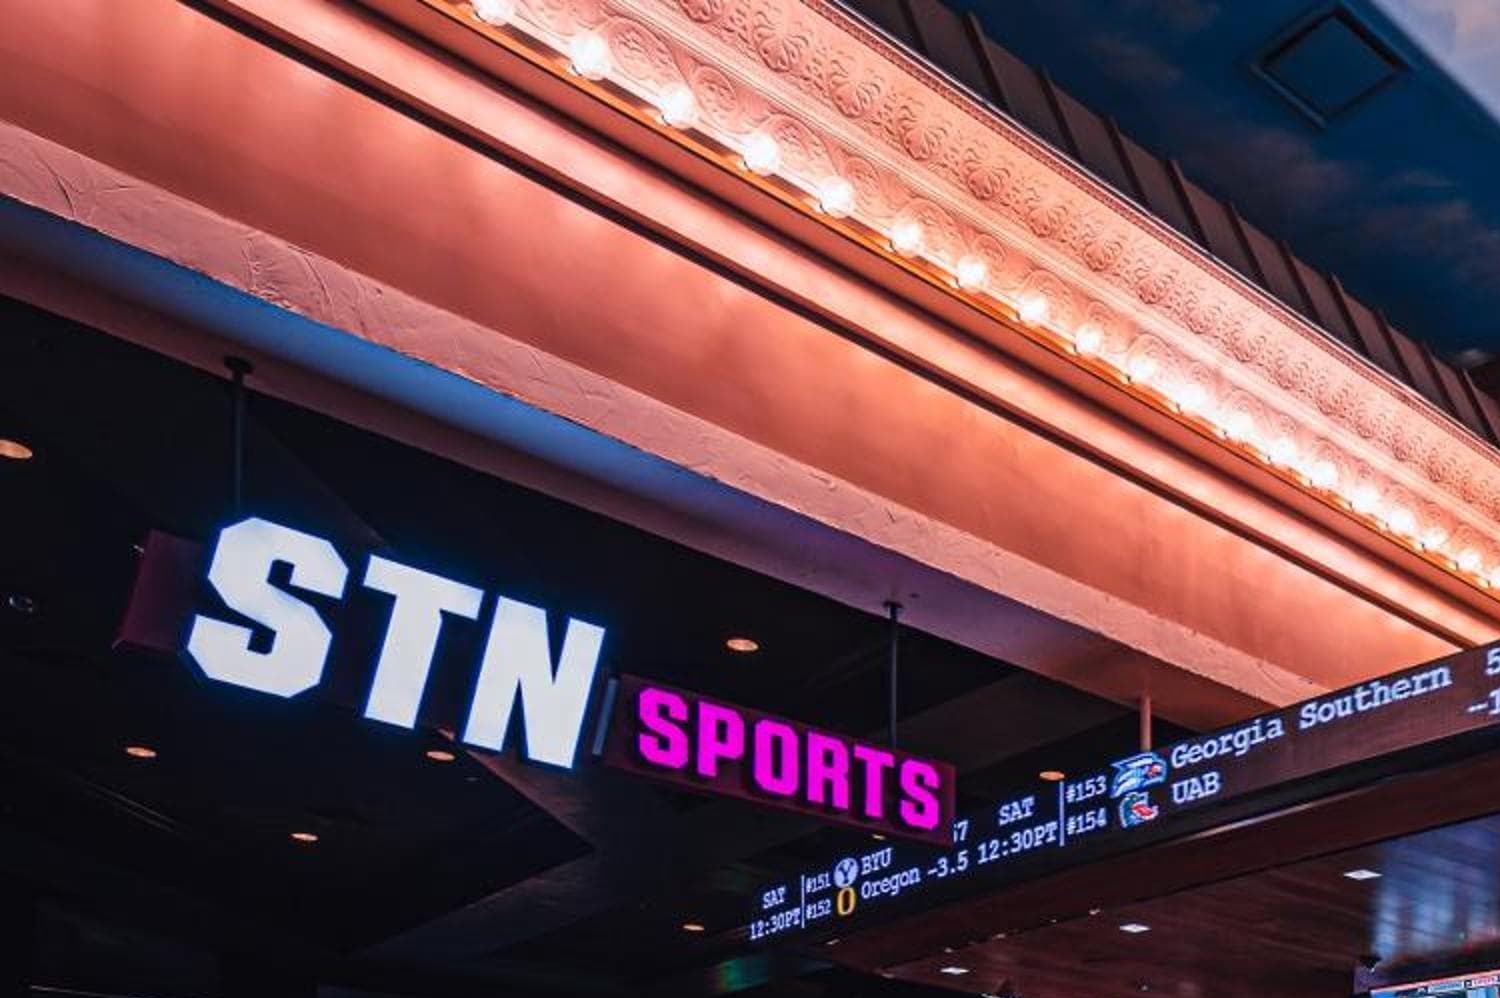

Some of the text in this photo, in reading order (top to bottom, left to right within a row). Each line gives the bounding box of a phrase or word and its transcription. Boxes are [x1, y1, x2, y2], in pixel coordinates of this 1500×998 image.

[187, 516, 942, 831] STN SPORTS
[1066, 775, 1107, 802] #153
[1171, 717, 1285, 769] Georgia
[1299, 665, 1454, 729] Southern
[860, 847, 894, 876] BYU
[998, 797, 1035, 826] SAT
[1066, 808, 1107, 836] #154
[1171, 771, 1221, 804] UAB
[762, 885, 787, 909] SAT
[860, 867, 921, 901] Oregon
[927, 850, 969, 879] -3.5
[976, 821, 1058, 864] 12:30PT
[748, 906, 801, 940] 12:30PT
